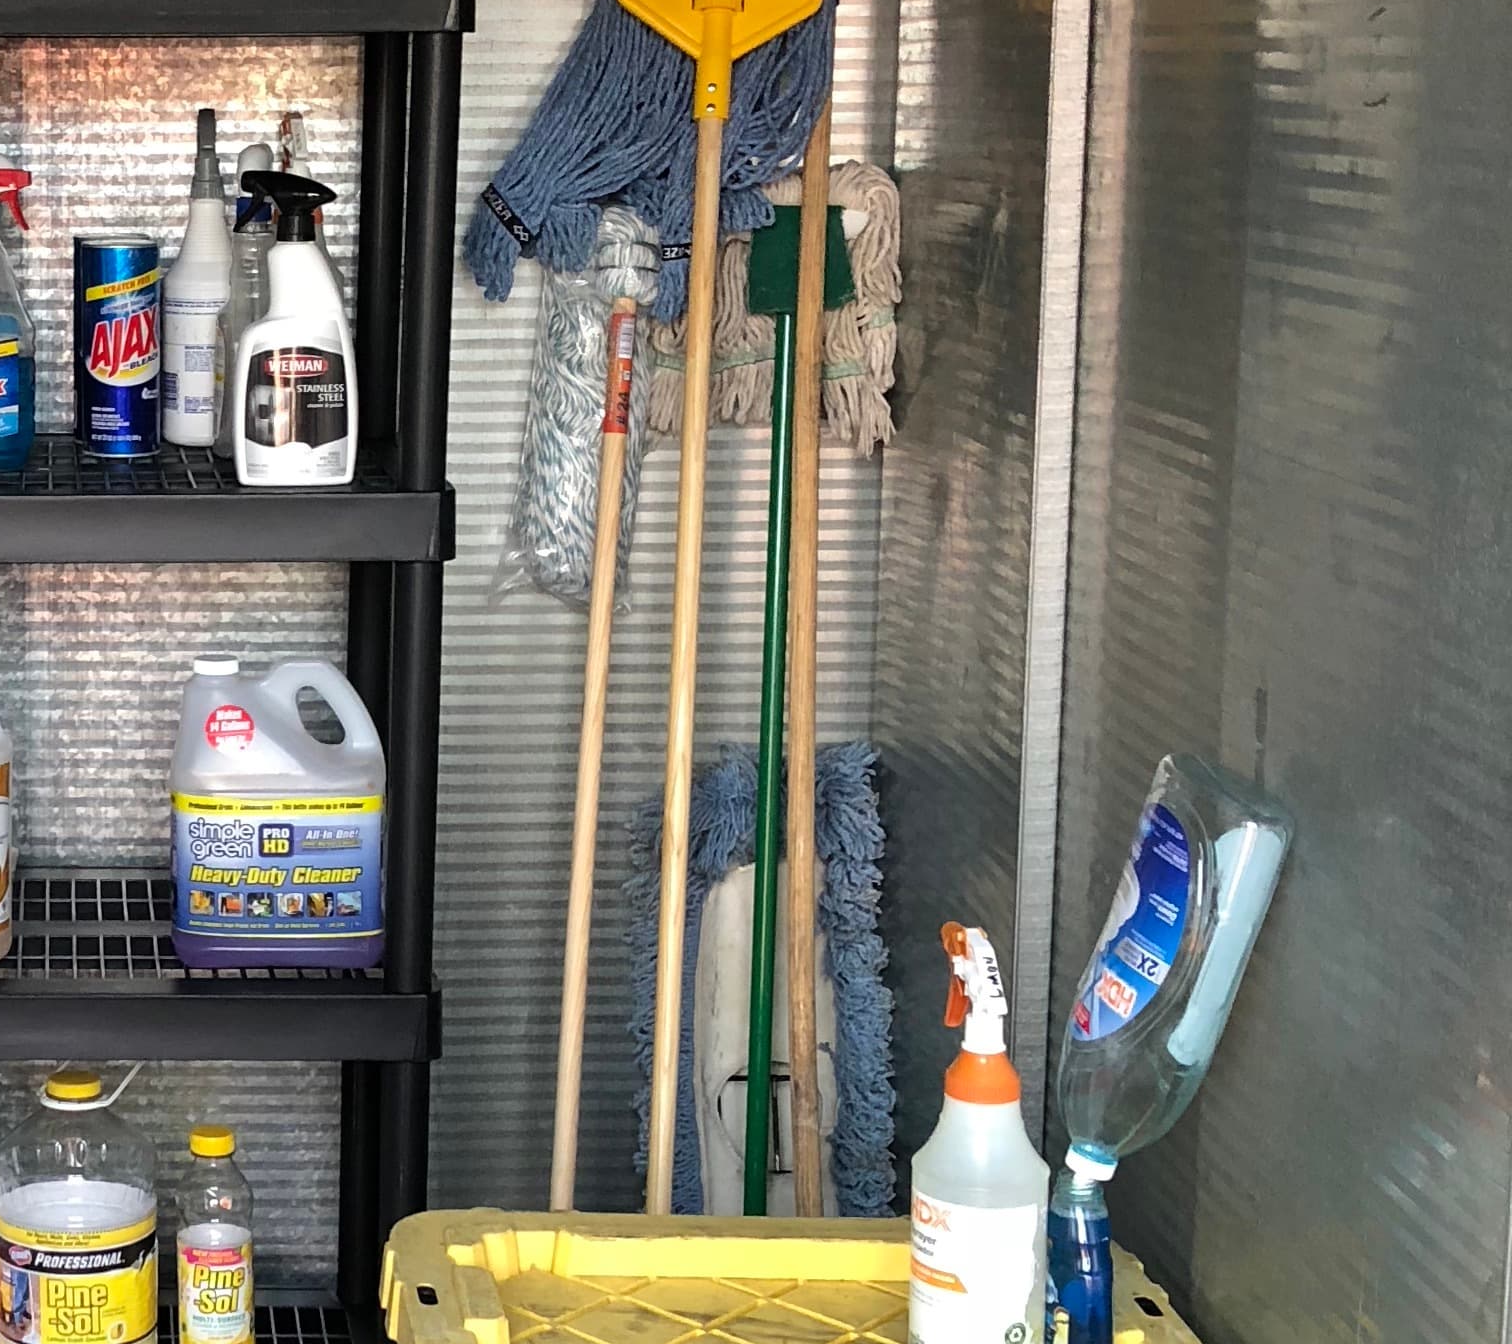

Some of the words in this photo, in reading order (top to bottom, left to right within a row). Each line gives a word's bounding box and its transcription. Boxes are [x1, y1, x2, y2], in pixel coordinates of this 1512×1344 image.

[89, 302, 159, 379] AJAX
[268, 359, 323, 373] WEIMAN
[296, 383, 345, 393] STAINLESS
[317, 393, 345, 402] STEEL
[190, 818, 253, 843] simple
[263, 827, 291, 839] PRO
[191, 840, 253, 860] green
[263, 839, 290, 854] HD
[190, 864, 287, 886] Heavy-Duty
[292, 866, 362, 885] Cleaner
[34, 1251, 123, 1270] PROFESSIONAL
[192, 1263, 246, 1289] Pine
[47, 1278, 109, 1308] Pine
